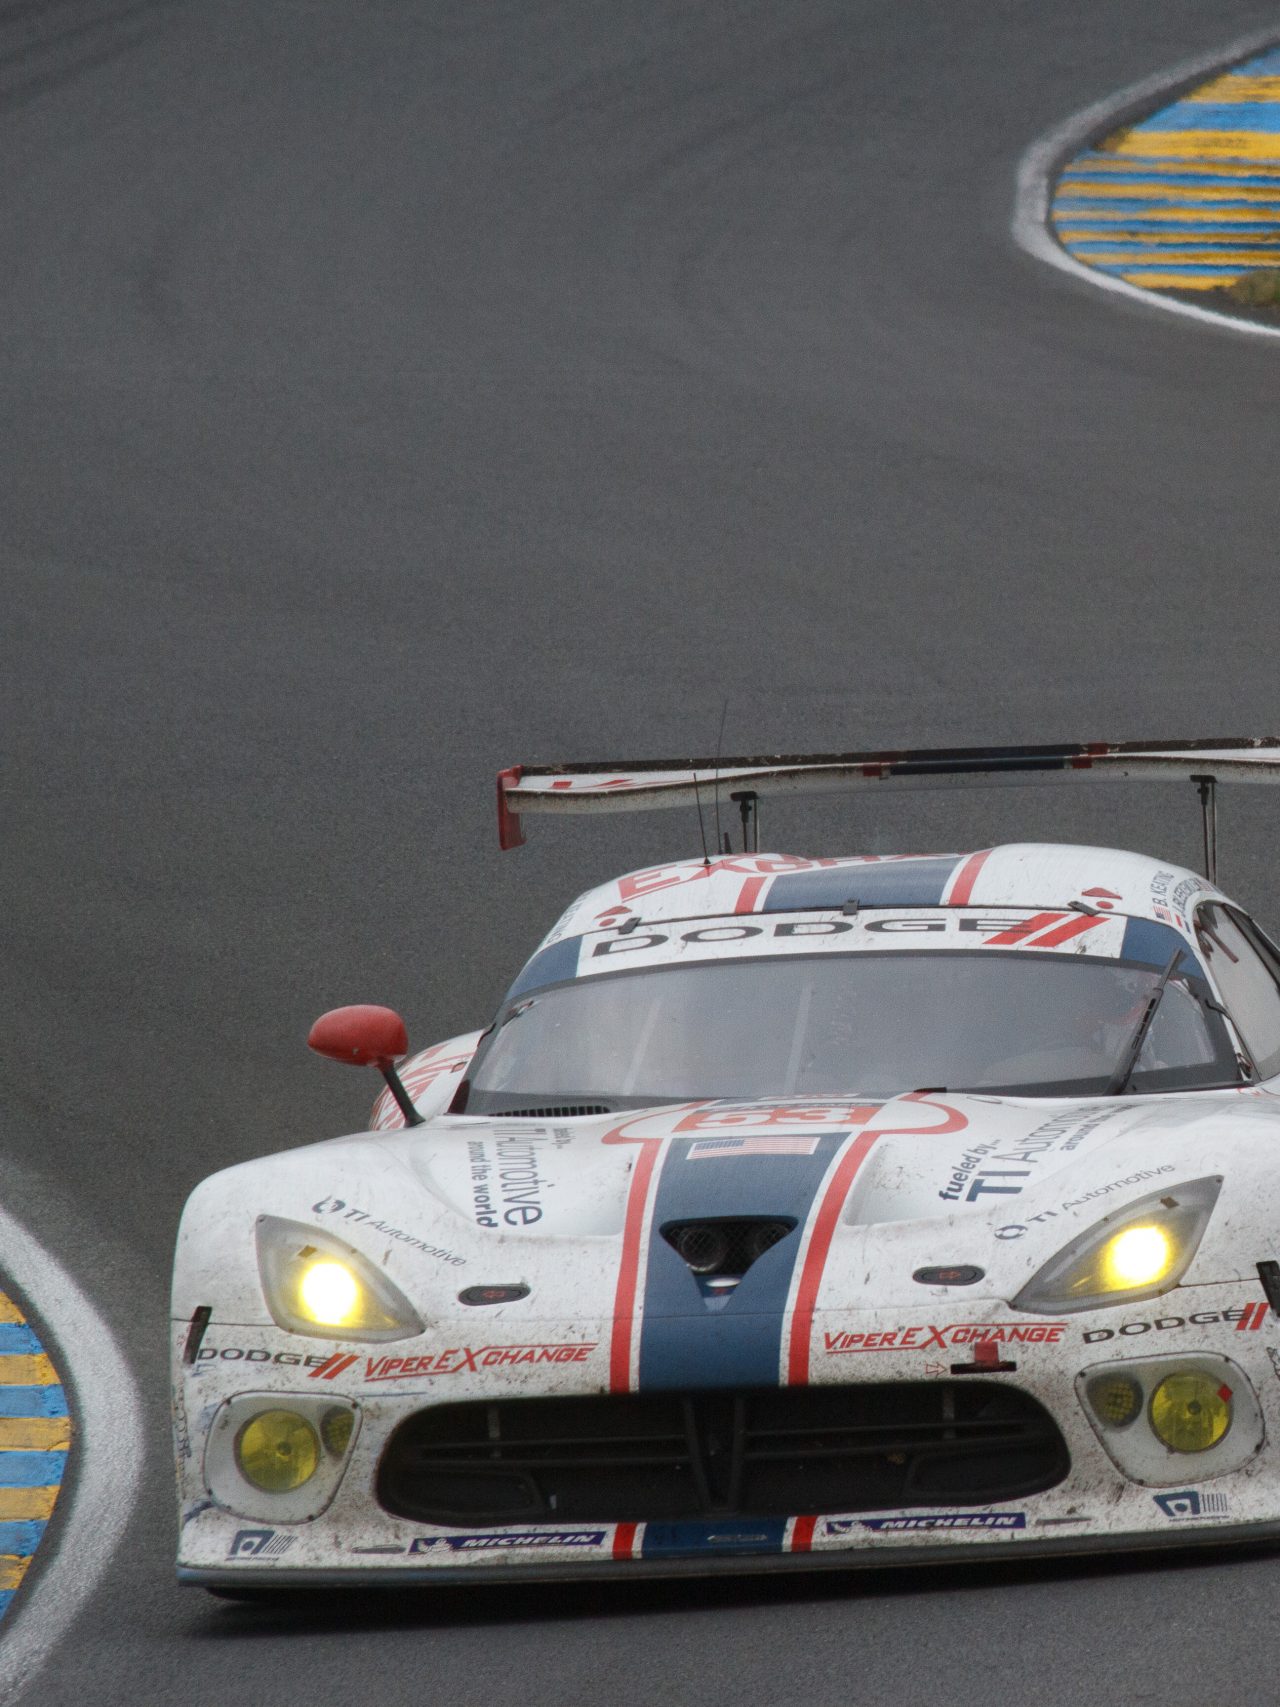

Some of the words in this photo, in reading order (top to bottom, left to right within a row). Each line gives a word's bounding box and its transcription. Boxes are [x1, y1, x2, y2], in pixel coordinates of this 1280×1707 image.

[592, 917, 1034, 957] DODGE
[695, 1107, 855, 1128] 53
[471, 1165, 492, 1181] the
[496, 1136, 555, 1226] Automotive
[939, 1152, 982, 1202] fueled
[965, 1171, 1031, 1202] TI
[473, 1184, 498, 1228] world
[1028, 1211, 1058, 1223] TI
[1062, 1164, 1176, 1211] Automotive
[343, 1208, 371, 1222] TI
[366, 1219, 467, 1267] Automotive
[1083, 1308, 1250, 1344] DODGE
[197, 1348, 330, 1369] DODGE
[881, 1515, 1017, 1530] MICHELIN
[462, 1533, 598, 1549] MICHELIN
